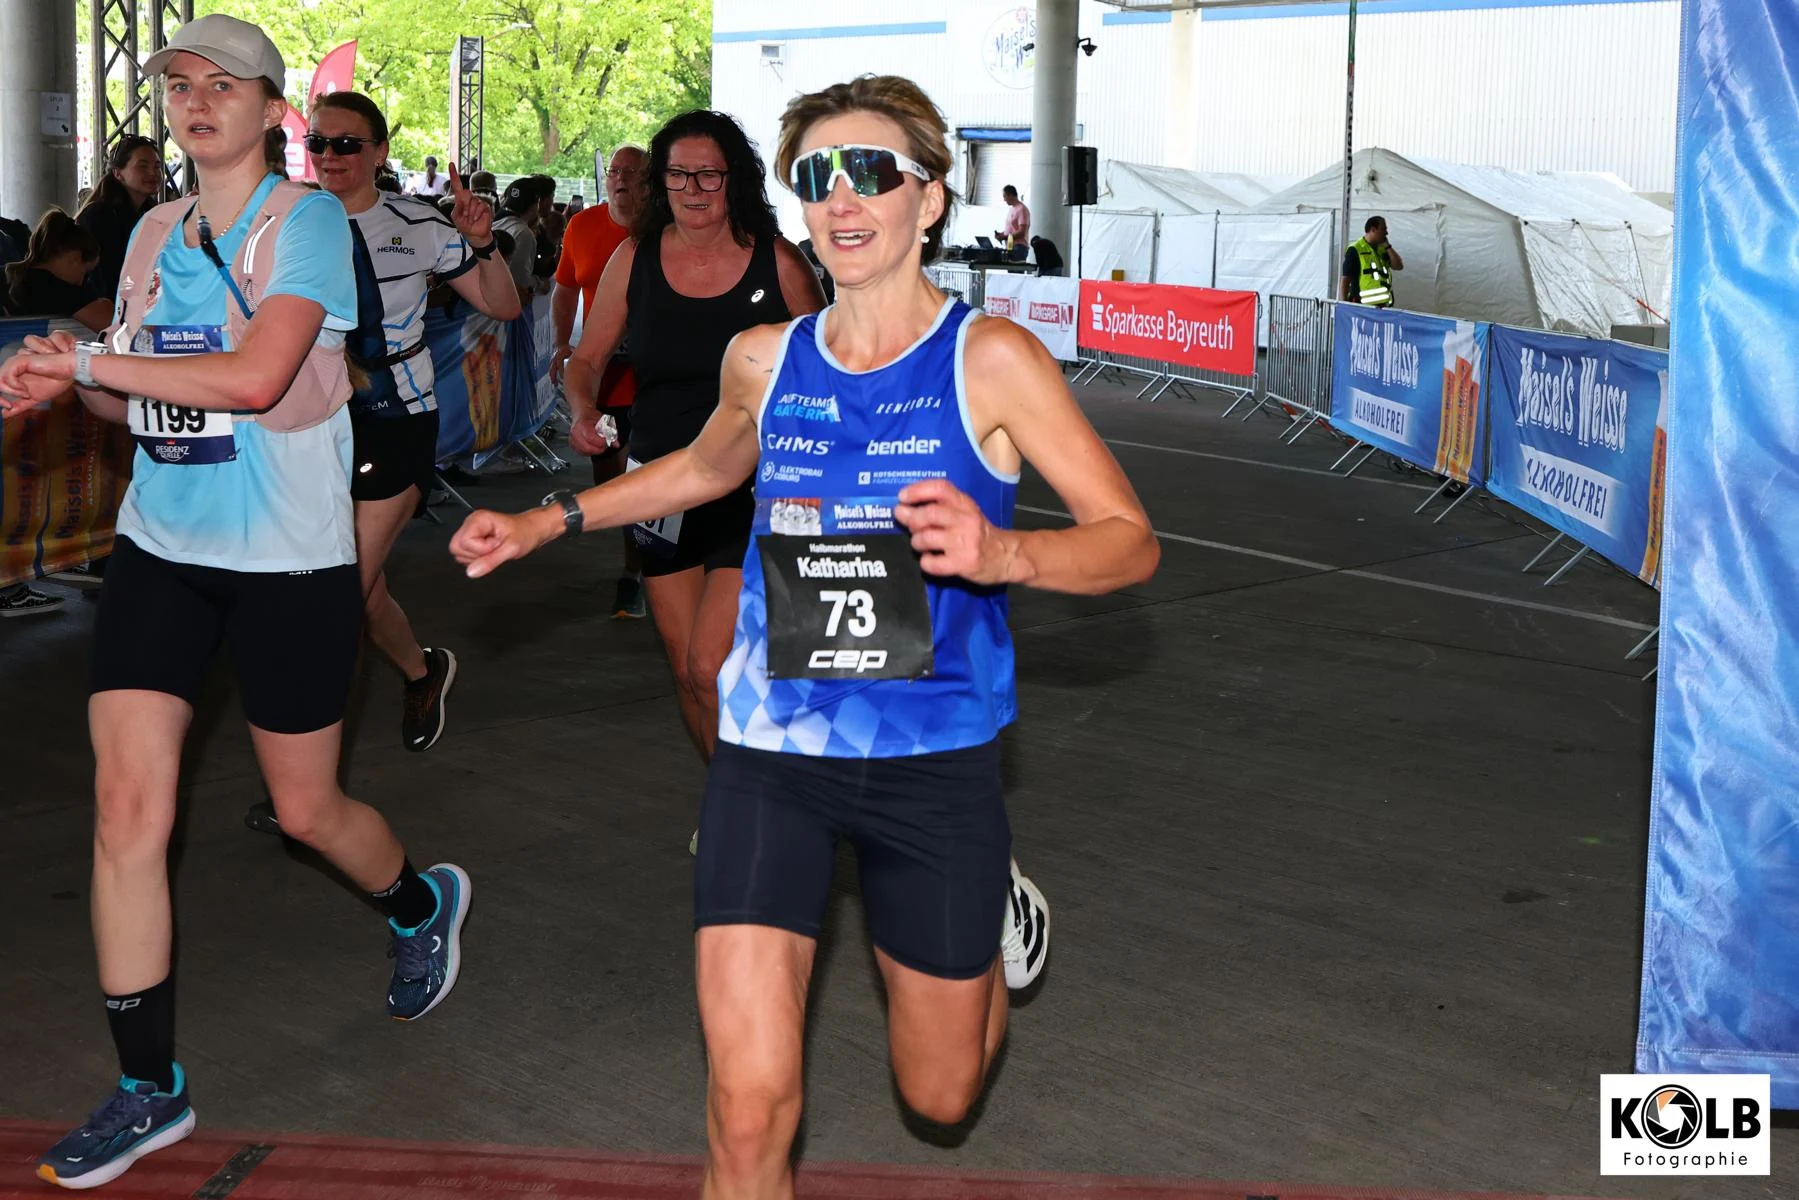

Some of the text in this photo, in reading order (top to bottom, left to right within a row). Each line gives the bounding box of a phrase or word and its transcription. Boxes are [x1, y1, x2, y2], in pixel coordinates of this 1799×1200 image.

[377, 246, 415, 255] HERMOS
[1105, 304, 1233, 352] Sparkasse Bayreuth
[1350, 316, 1420, 390] Maisel's Weisse
[1516, 347, 1575, 436] Maisel's
[1578, 356, 1629, 454] Weisse
[141, 398, 206, 434] 1199
[866, 435, 941, 456] bender
[809, 543, 866, 553] Halbmarathon
[797, 556, 888, 578] Katharina
[819, 589, 877, 638] 73
[808, 650, 888, 673] cep
[105, 998, 141, 1011] ep
